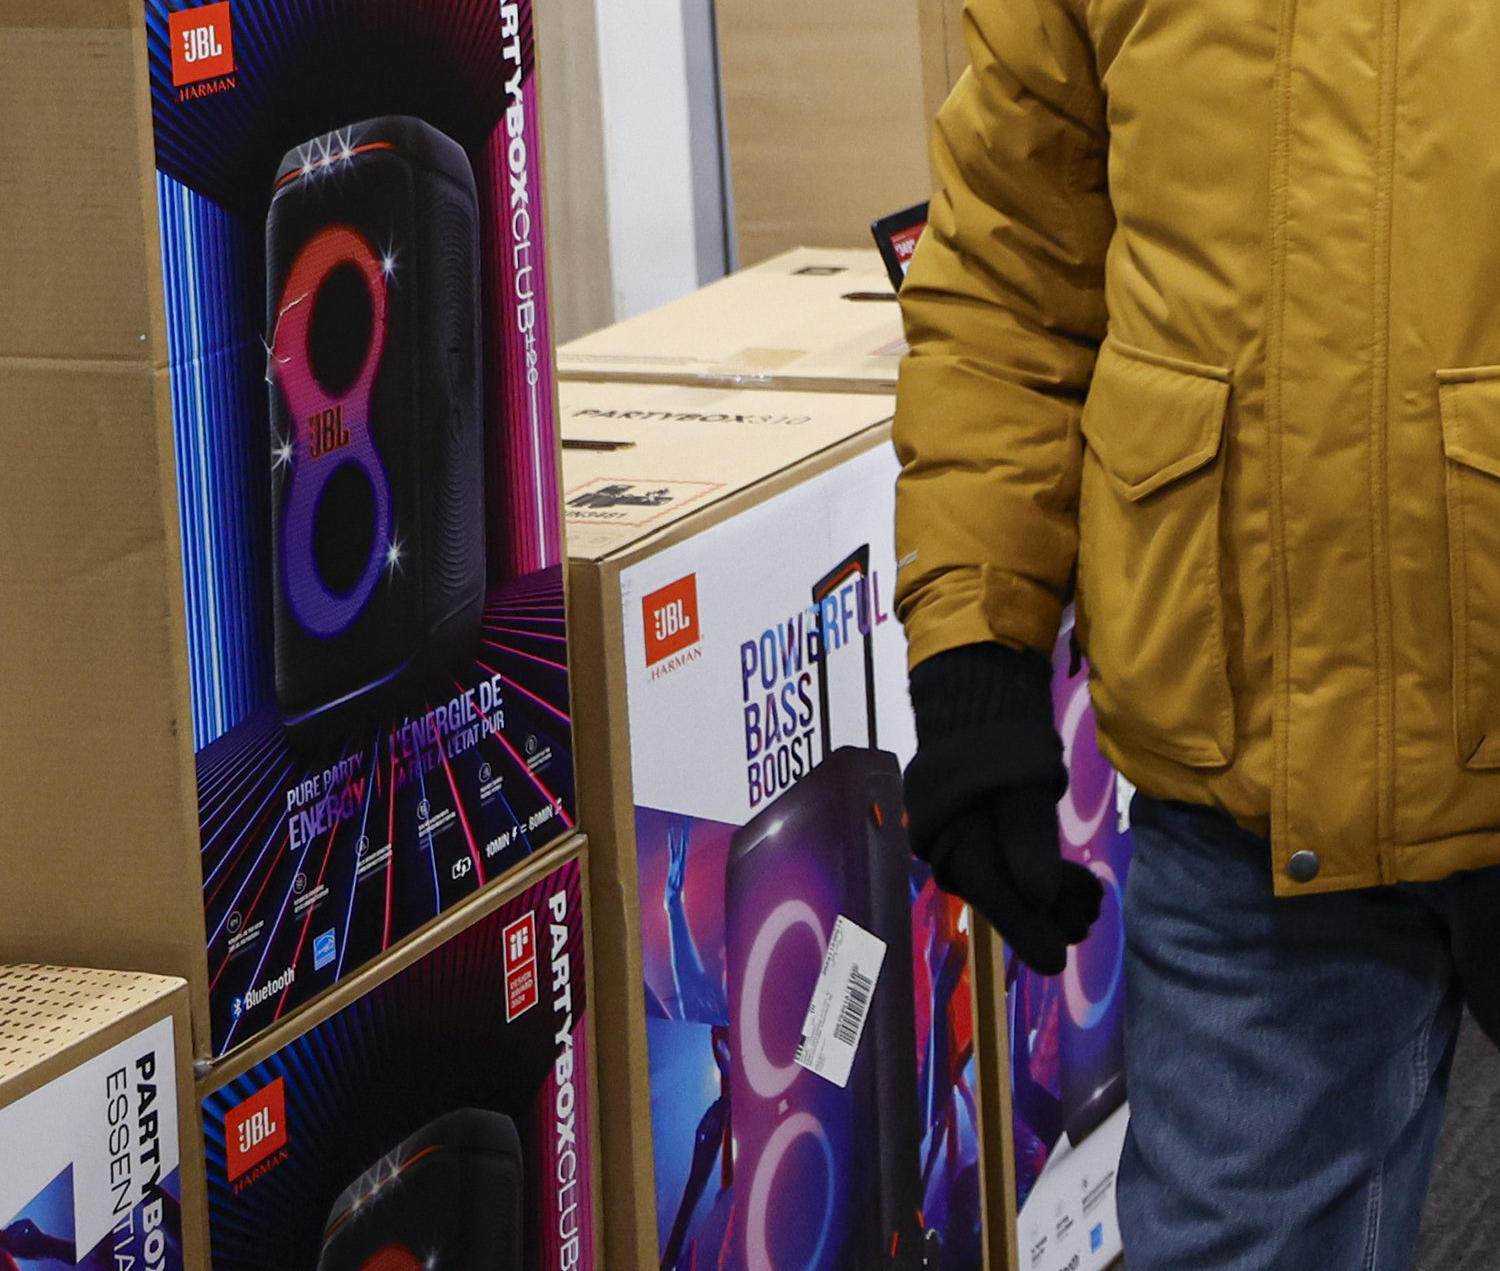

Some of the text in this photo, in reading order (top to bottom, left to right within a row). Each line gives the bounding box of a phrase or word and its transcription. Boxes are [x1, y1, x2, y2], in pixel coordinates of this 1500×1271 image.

[183, 25, 222, 63] JBL
[179, 76, 237, 102] HARMAN
[309, 402, 352, 460] JBL
[654, 598, 691, 642] JBL
[740, 570, 888, 703] POWERFUL
[650, 646, 703, 681] HARMAN
[479, 673, 504, 714] DE
[744, 672, 815, 762] BASS
[481, 709, 505, 740] PUR
[286, 750, 364, 812] PURE PARTY
[747, 727, 816, 810] BOOST
[288, 776, 366, 852] ENERGY
[244, 963, 296, 1011] Bluetooth
[238, 1106, 277, 1154] JBL
[233, 1149, 289, 1195] HARMAN
